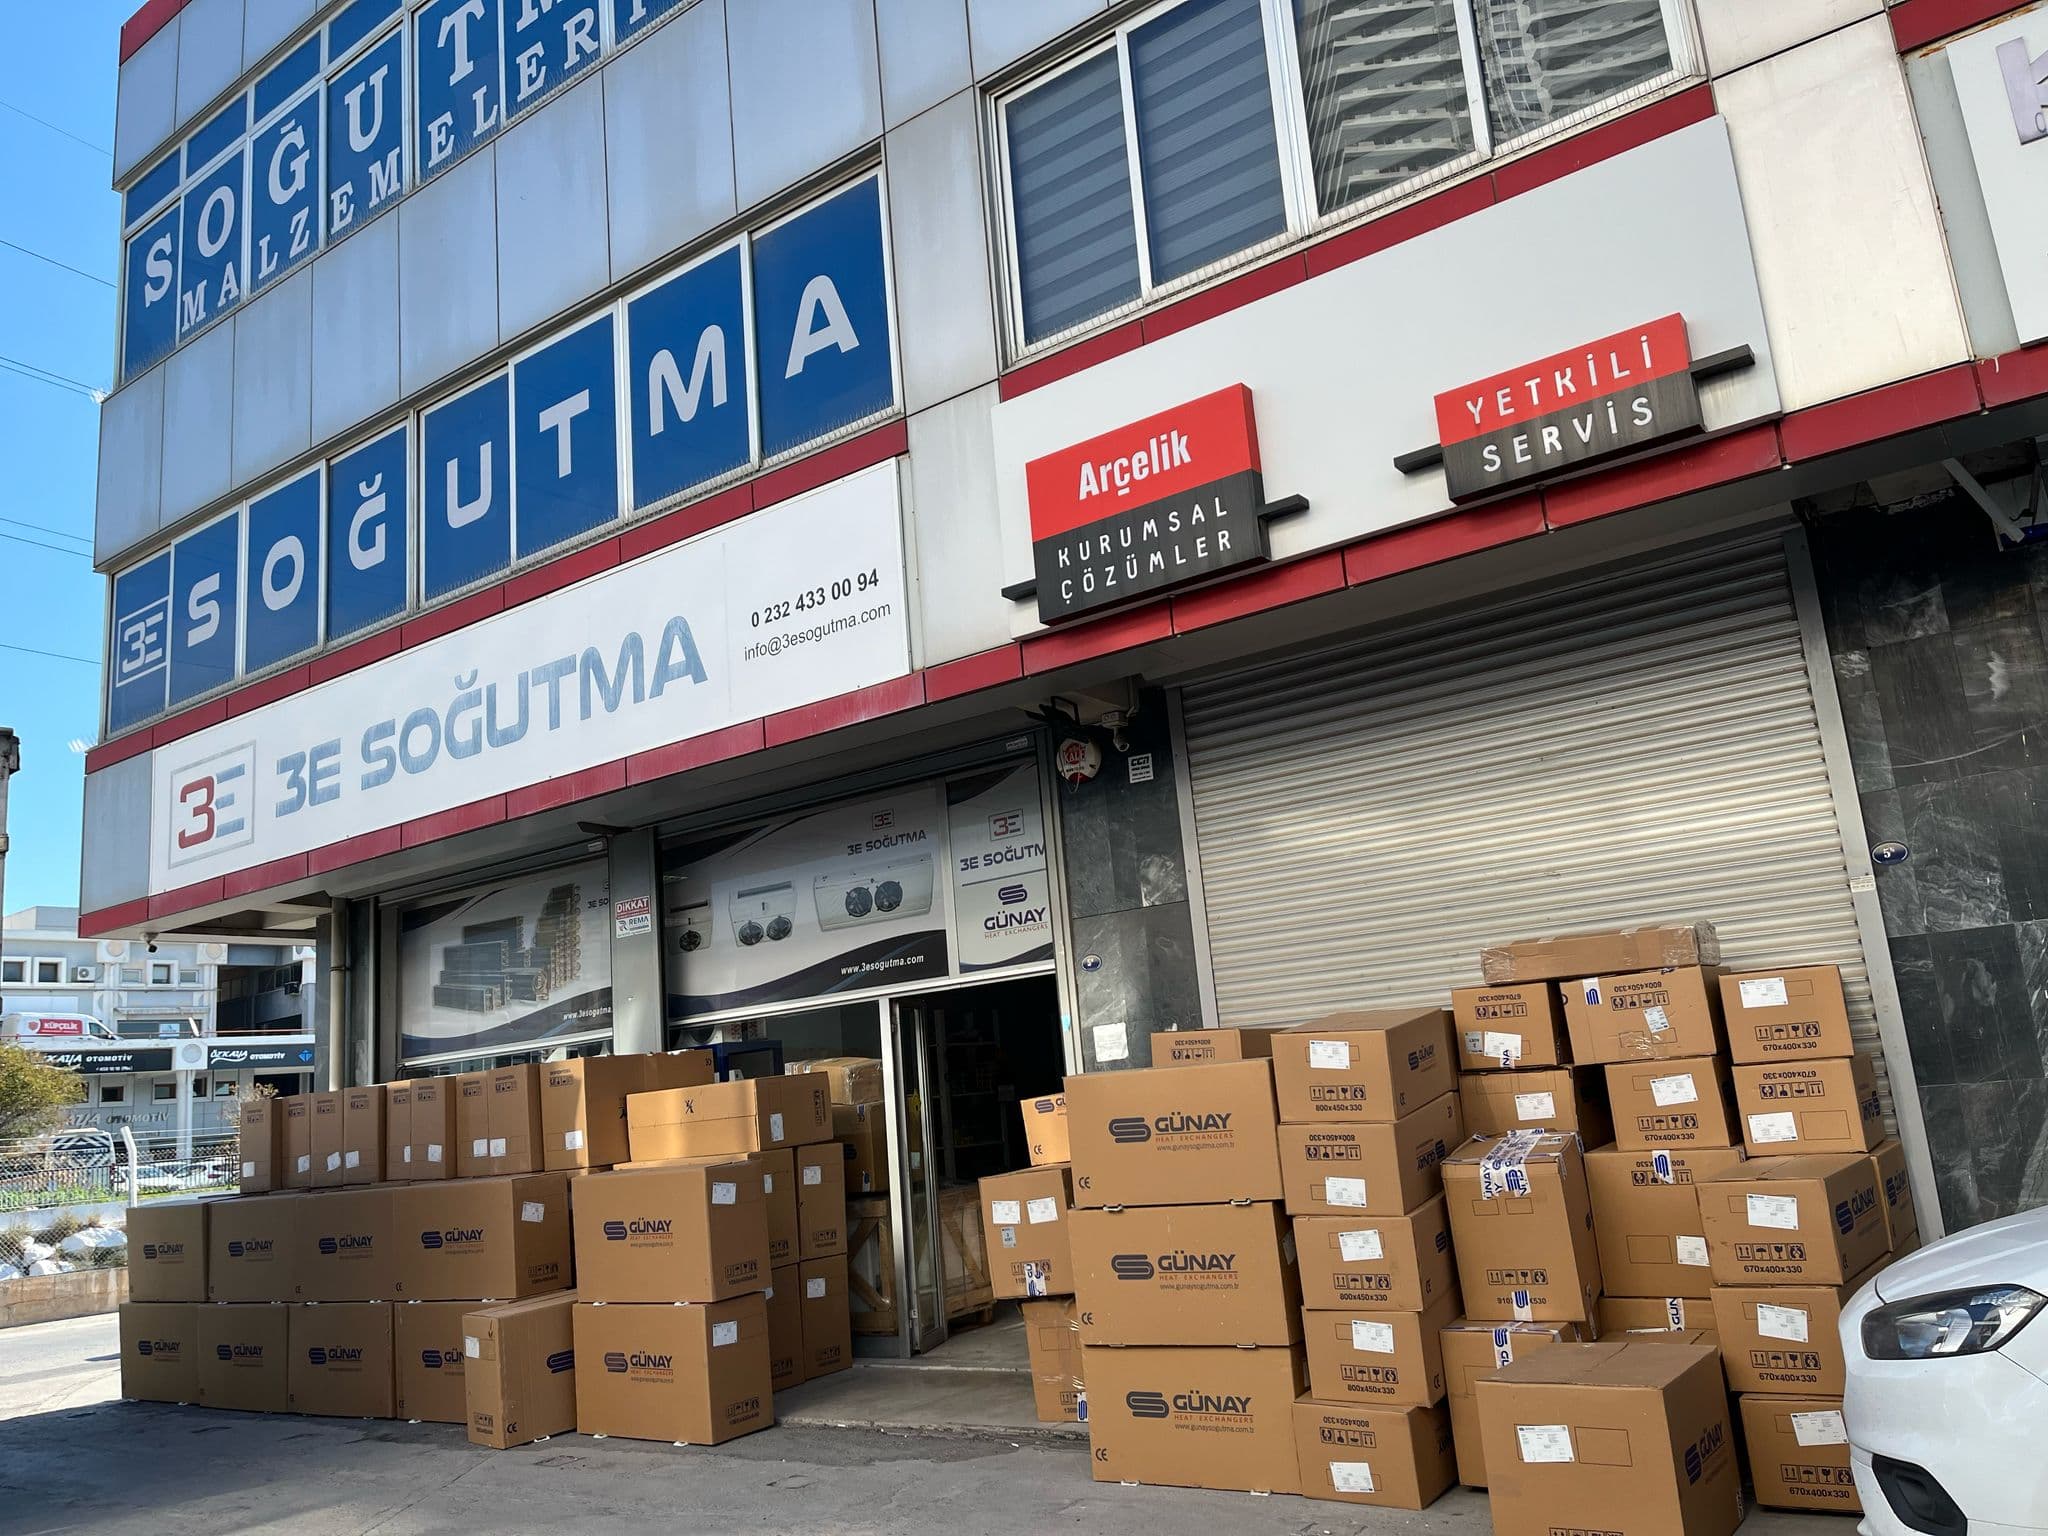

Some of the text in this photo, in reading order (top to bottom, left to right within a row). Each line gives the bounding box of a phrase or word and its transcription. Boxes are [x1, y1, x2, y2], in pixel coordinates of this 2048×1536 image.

[1465, 333, 1654, 426] YETKİLİ
[1482, 394, 1654, 473] SERVİS
[187, 274, 860, 647] SOĞUTMA
[1079, 427, 1193, 503] Arçelik
[1057, 495, 1228, 568] KURUMSAL
[1060, 528, 1232, 605] ÇÖZÜMLER
[750, 568, 881, 628] 0 232 433 00 94
[744, 601, 892, 662] info@3esogutma.com
[275, 615, 709, 820] 3E SOĞUTMA
[847, 829, 927, 856] 3E SOĞUTMA
[960, 856, 979, 871] 3E
[616, 898, 649, 913] DİKKAT
[984, 907, 1047, 931] GÜNAY
[1004, 923, 1049, 937] EXCHANGERS
[841, 954, 924, 975] www.3esogutma.com
[1762, 1041, 1818, 1052] 670x400x330
[85, 1054, 133, 1063] OTOMOTİV
[1762, 1070, 1817, 1080] 670x400x330
[1315, 1103, 1363, 1112] 800x450x330
[1154, 1111, 1232, 1133] GÜNAY
[1155, 1132, 1234, 1142] HEAT EXCHANGERS
[1644, 1132, 1696, 1142] 670x400x330
[629, 1217, 673, 1233] GÜNAY
[338, 1234, 374, 1248] GÜNAY
[444, 1228, 485, 1241] GÜNAY
[1157, 1250, 1237, 1271] GÜNAY
[1184, 1272, 1239, 1281] EXCHANGERS
[1743, 1264, 1803, 1274] 670x400x330
[1339, 1292, 1388, 1302] 800x450x330
[328, 1347, 363, 1359] GÜNAY
[630, 1350, 673, 1368] GÜNAY
[1758, 1372, 1817, 1383] 670x400x330
[1347, 1383, 1396, 1395] 800x450x330
[1173, 1390, 1252, 1414] GÜNAY
[1174, 1414, 1255, 1424] HEAT EXCHANGERS
[1322, 1415, 1370, 1428] 800x450x330
[1789, 1486, 1850, 1499] 670x400x330
